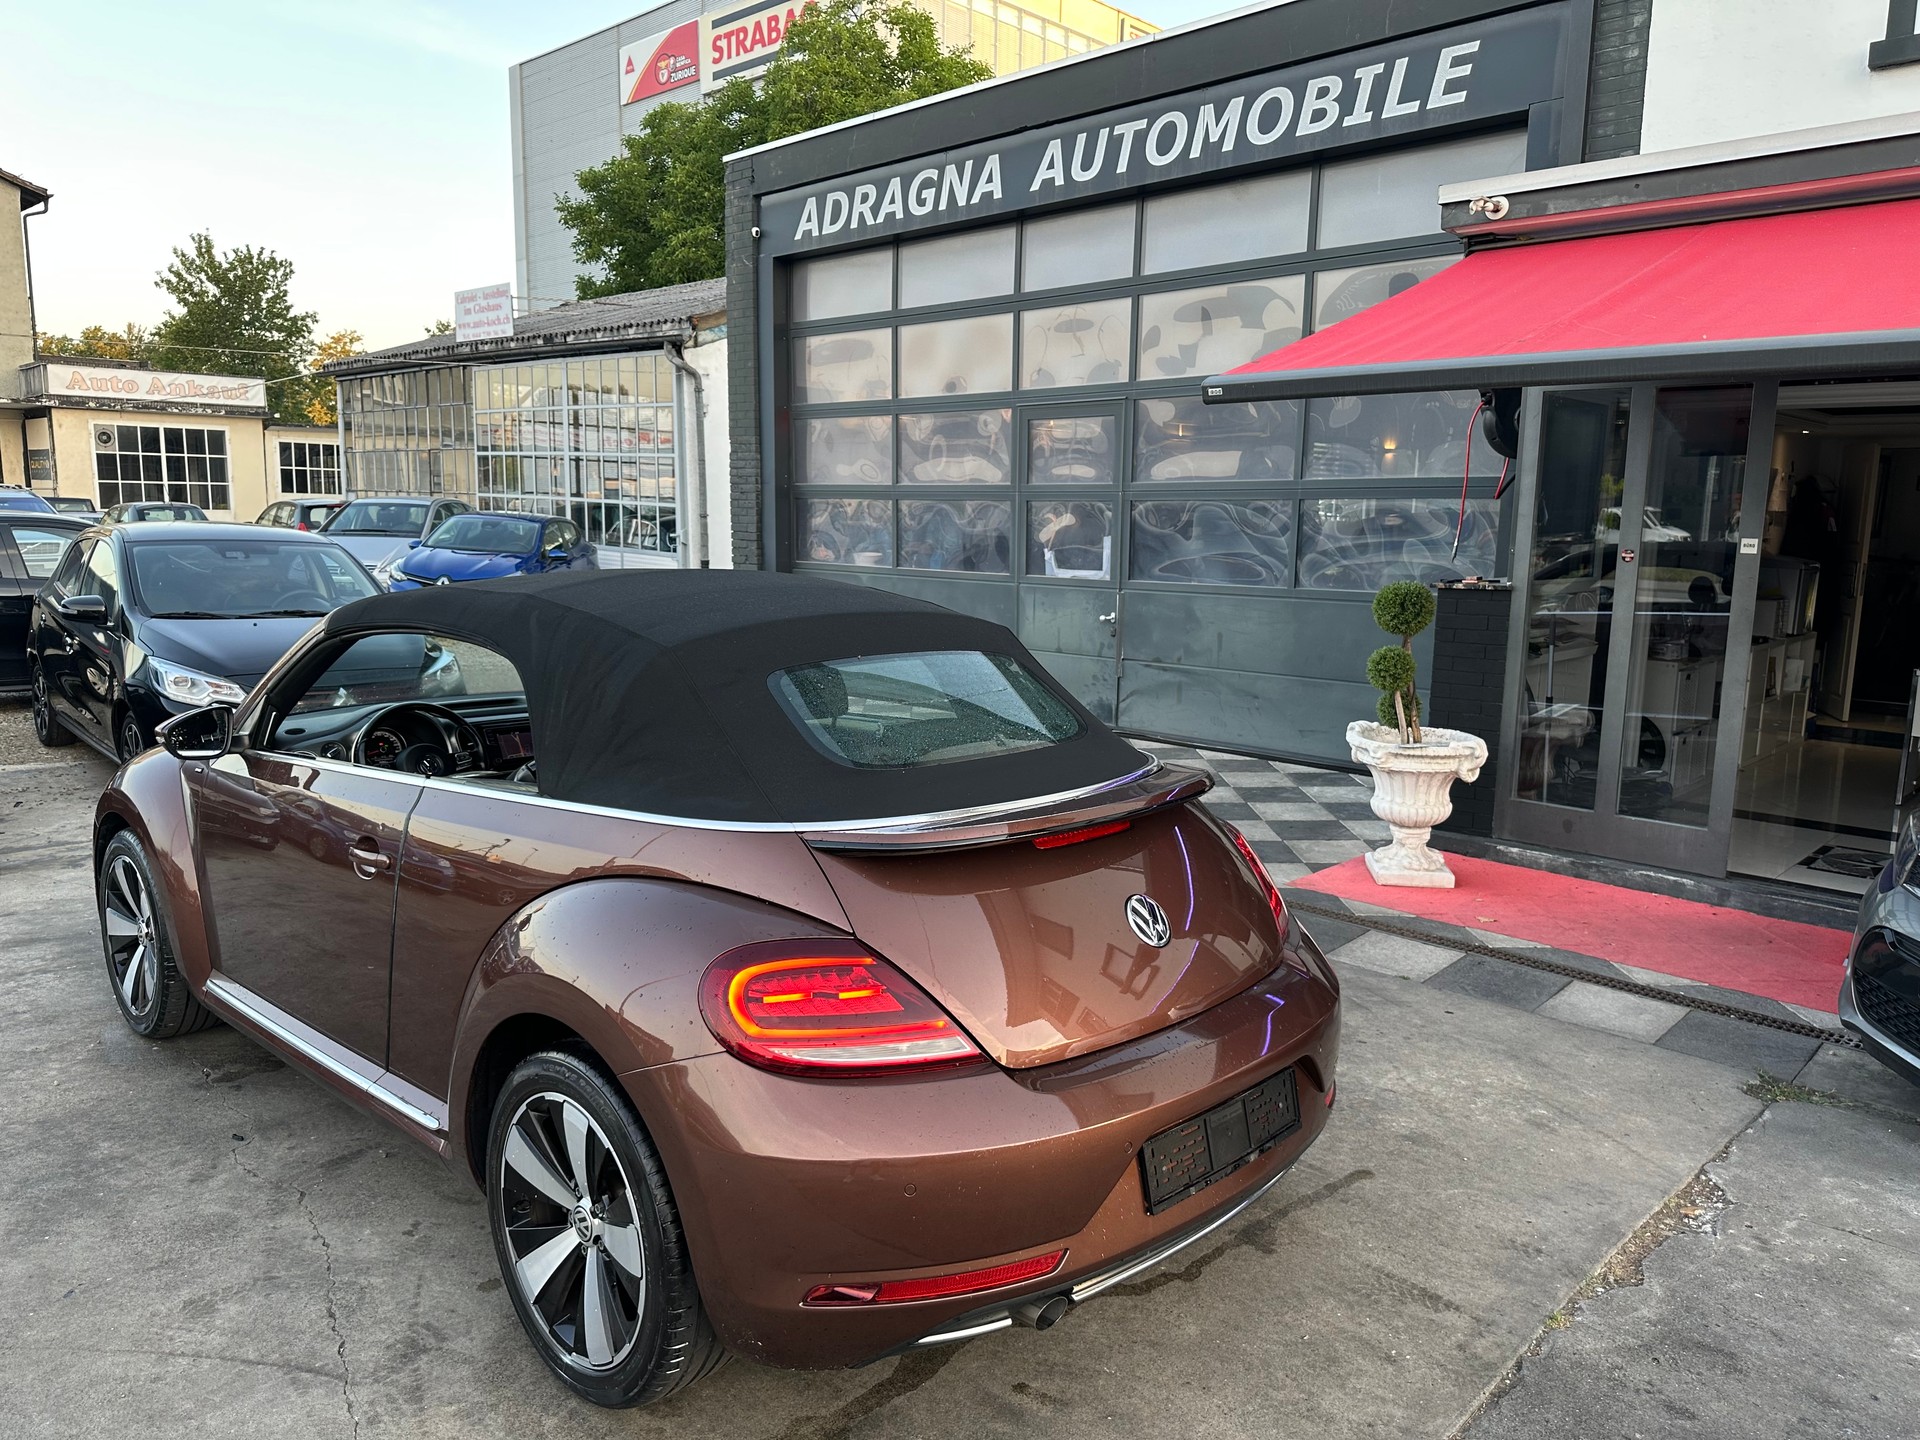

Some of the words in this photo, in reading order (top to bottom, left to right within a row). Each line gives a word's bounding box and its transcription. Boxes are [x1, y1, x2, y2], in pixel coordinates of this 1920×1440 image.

[670, 65, 696, 82] ZURIQUE
[794, 153, 1003, 241] ADRAGNA
[1029, 39, 1482, 193] AUTOMOBILE
[473, 302, 502, 314] Glashaus
[66, 370, 139, 394] Auto
[146, 376, 250, 401] Ankauf
